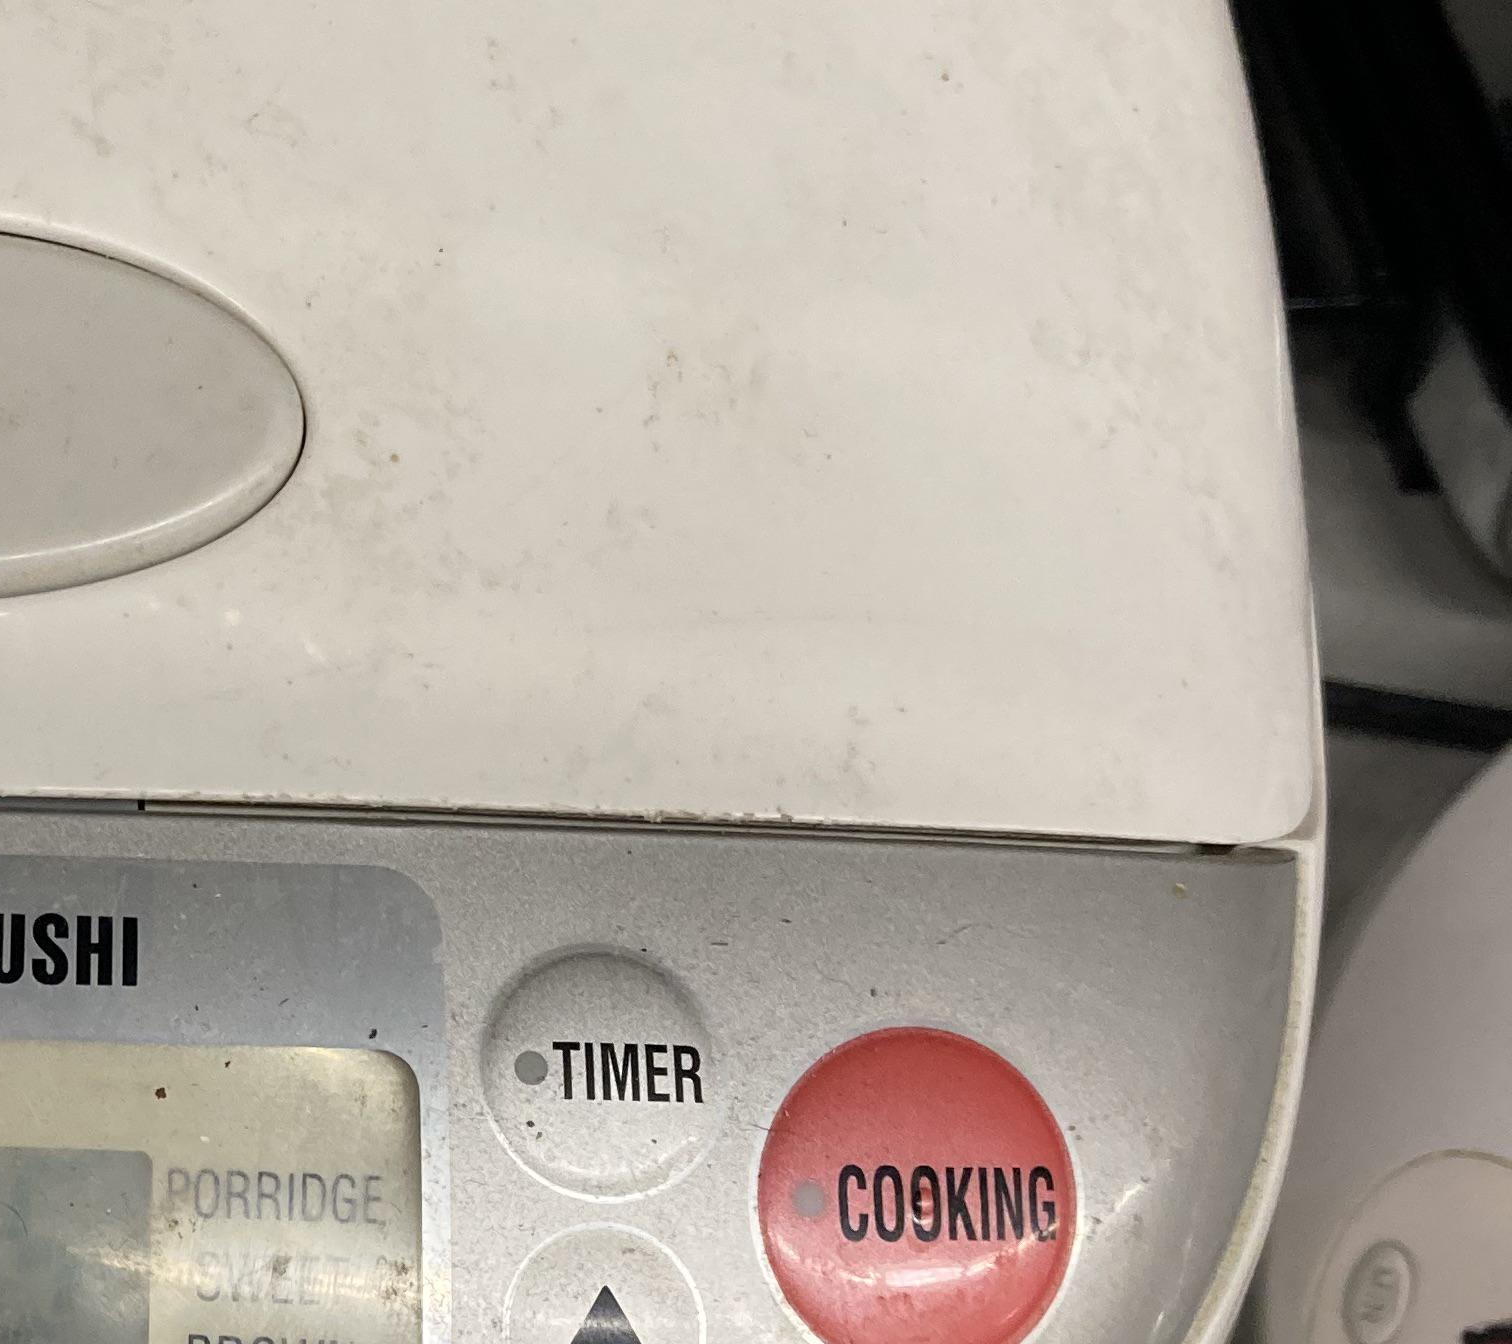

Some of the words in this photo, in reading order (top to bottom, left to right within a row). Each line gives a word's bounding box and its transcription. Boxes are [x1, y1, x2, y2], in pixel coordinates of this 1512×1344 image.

[552, 1040, 704, 1104] TIMER
[167, 1167, 387, 1226] PORRIDGE
[837, 1163, 1057, 1243] COOKING
